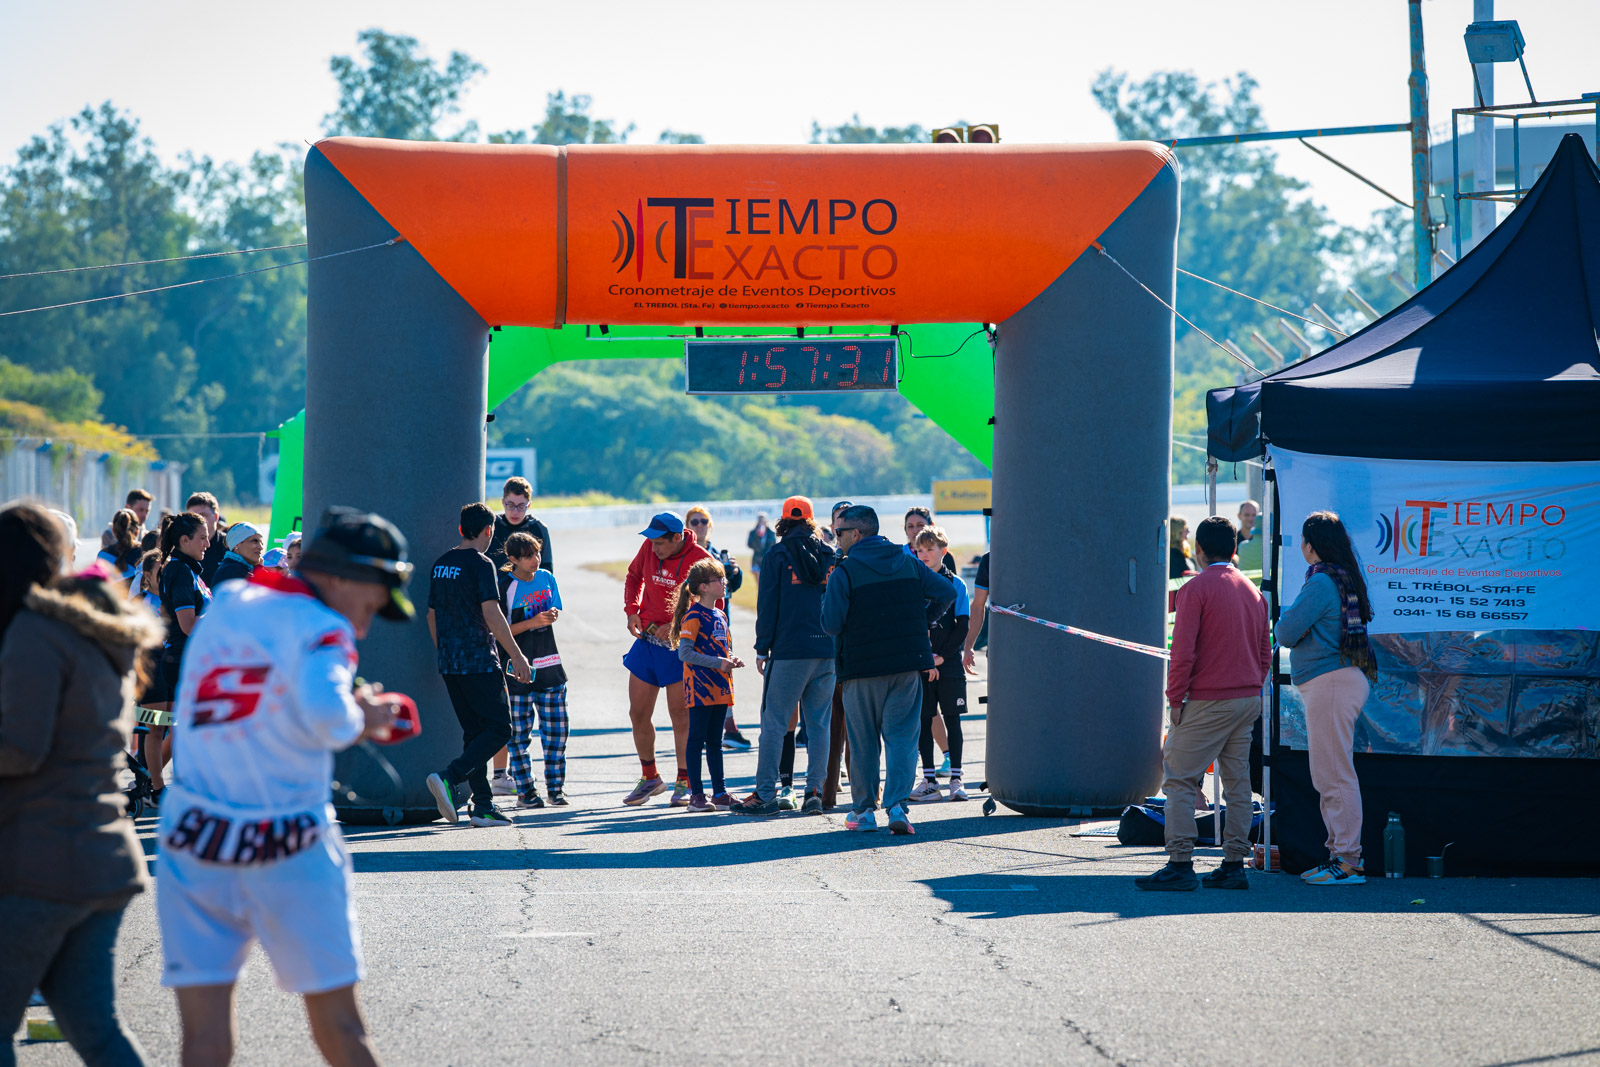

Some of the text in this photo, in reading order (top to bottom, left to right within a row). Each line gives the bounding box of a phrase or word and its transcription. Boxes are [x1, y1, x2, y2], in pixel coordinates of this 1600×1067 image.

[647, 197, 898, 279] TIEMPO
[688, 209, 898, 281] EXACTO
[608, 284, 896, 299] Cronometraje de Eventos Deportivos
[805, 302, 839, 310] Tiempo
[738, 345, 892, 388] 1:57:31
[1405, 499, 1566, 557] TIEMPO
[1428, 511, 1567, 561] EXACTO
[433, 565, 461, 580] STAFF
[1366, 564, 1562, 579] Cronometraje de Eventos Deportivos
[1387, 581, 1407, 590] EL
[1396, 595, 1526, 607] 03401- 15 52 7413
[1393, 608, 1529, 621] 0341- 15 68 66557
